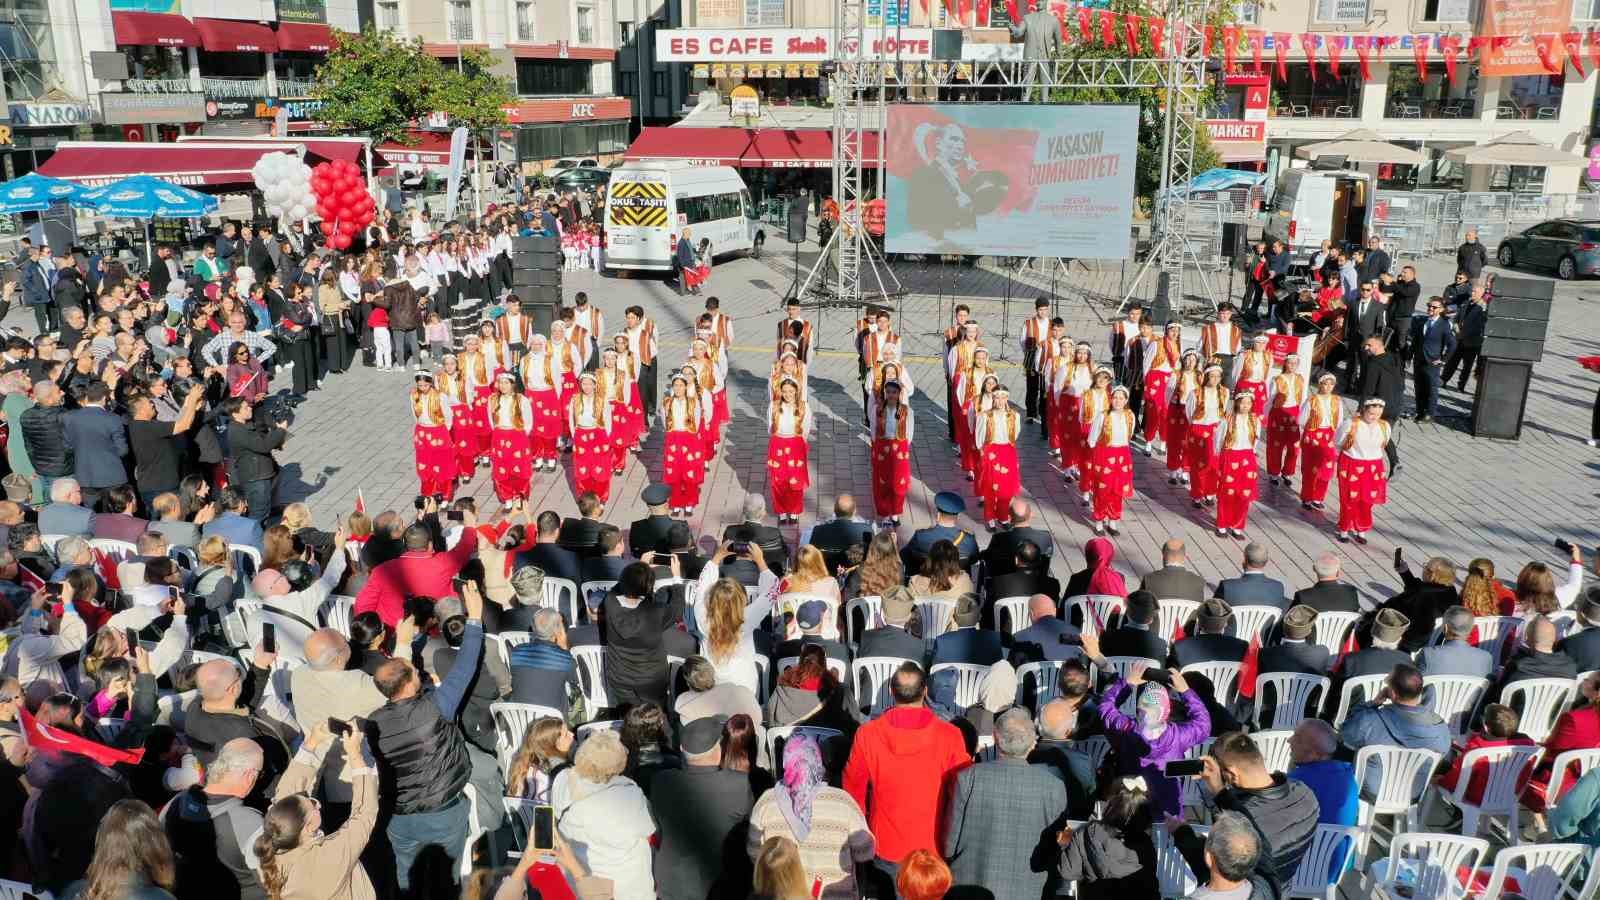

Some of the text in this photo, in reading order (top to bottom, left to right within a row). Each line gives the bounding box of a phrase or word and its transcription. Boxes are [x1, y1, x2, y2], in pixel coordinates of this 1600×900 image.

[671, 38, 699, 55] ES
[709, 37, 773, 55] CAFE
[872, 37, 930, 55] KÖFTE
[571, 103, 594, 117] KFC
[1206, 124, 1258, 138] MARKET
[383, 153, 405, 162] COFFEE
[610, 198, 667, 209] OKUL TAŞITI
